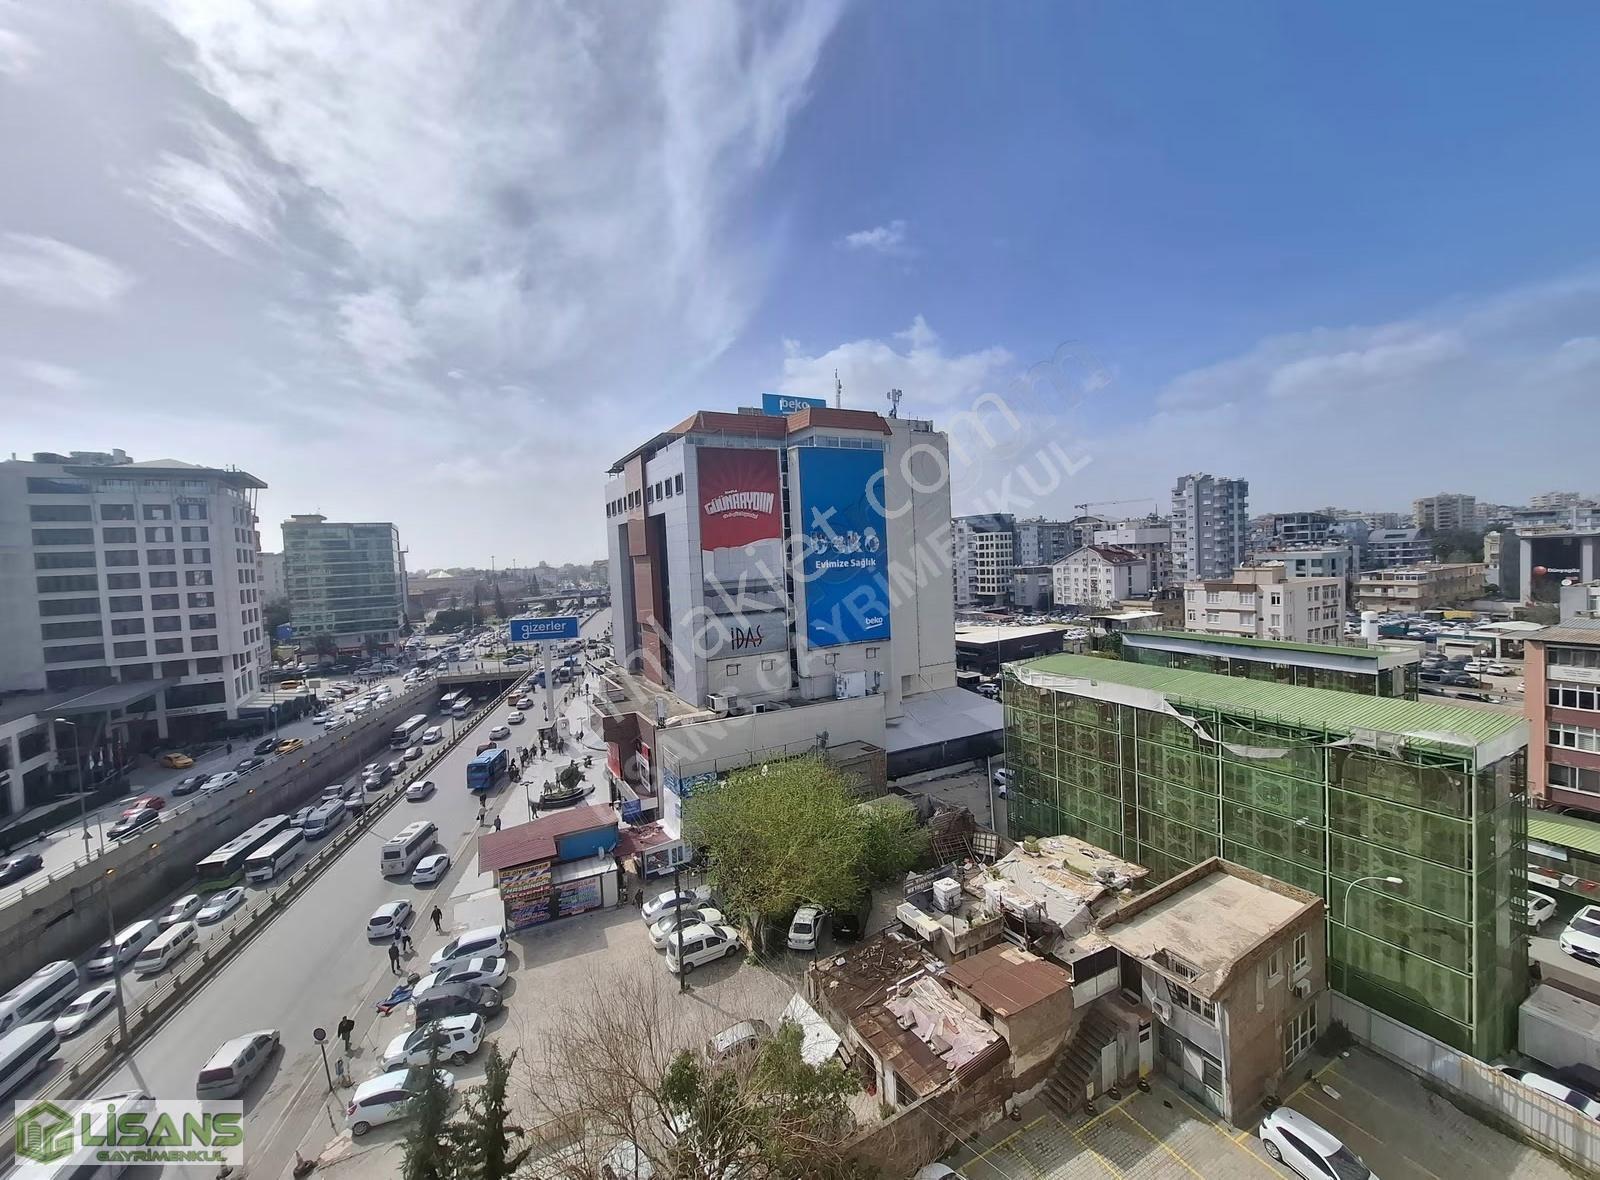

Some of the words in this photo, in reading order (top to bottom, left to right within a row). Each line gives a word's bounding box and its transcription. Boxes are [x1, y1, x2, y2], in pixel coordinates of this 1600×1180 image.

[780, 398, 809, 409] beko
[815, 560, 849, 569] Evimize
[850, 558, 876, 569] Sağlık
[865, 617, 883, 625] beko
[522, 620, 567, 639] gizerler
